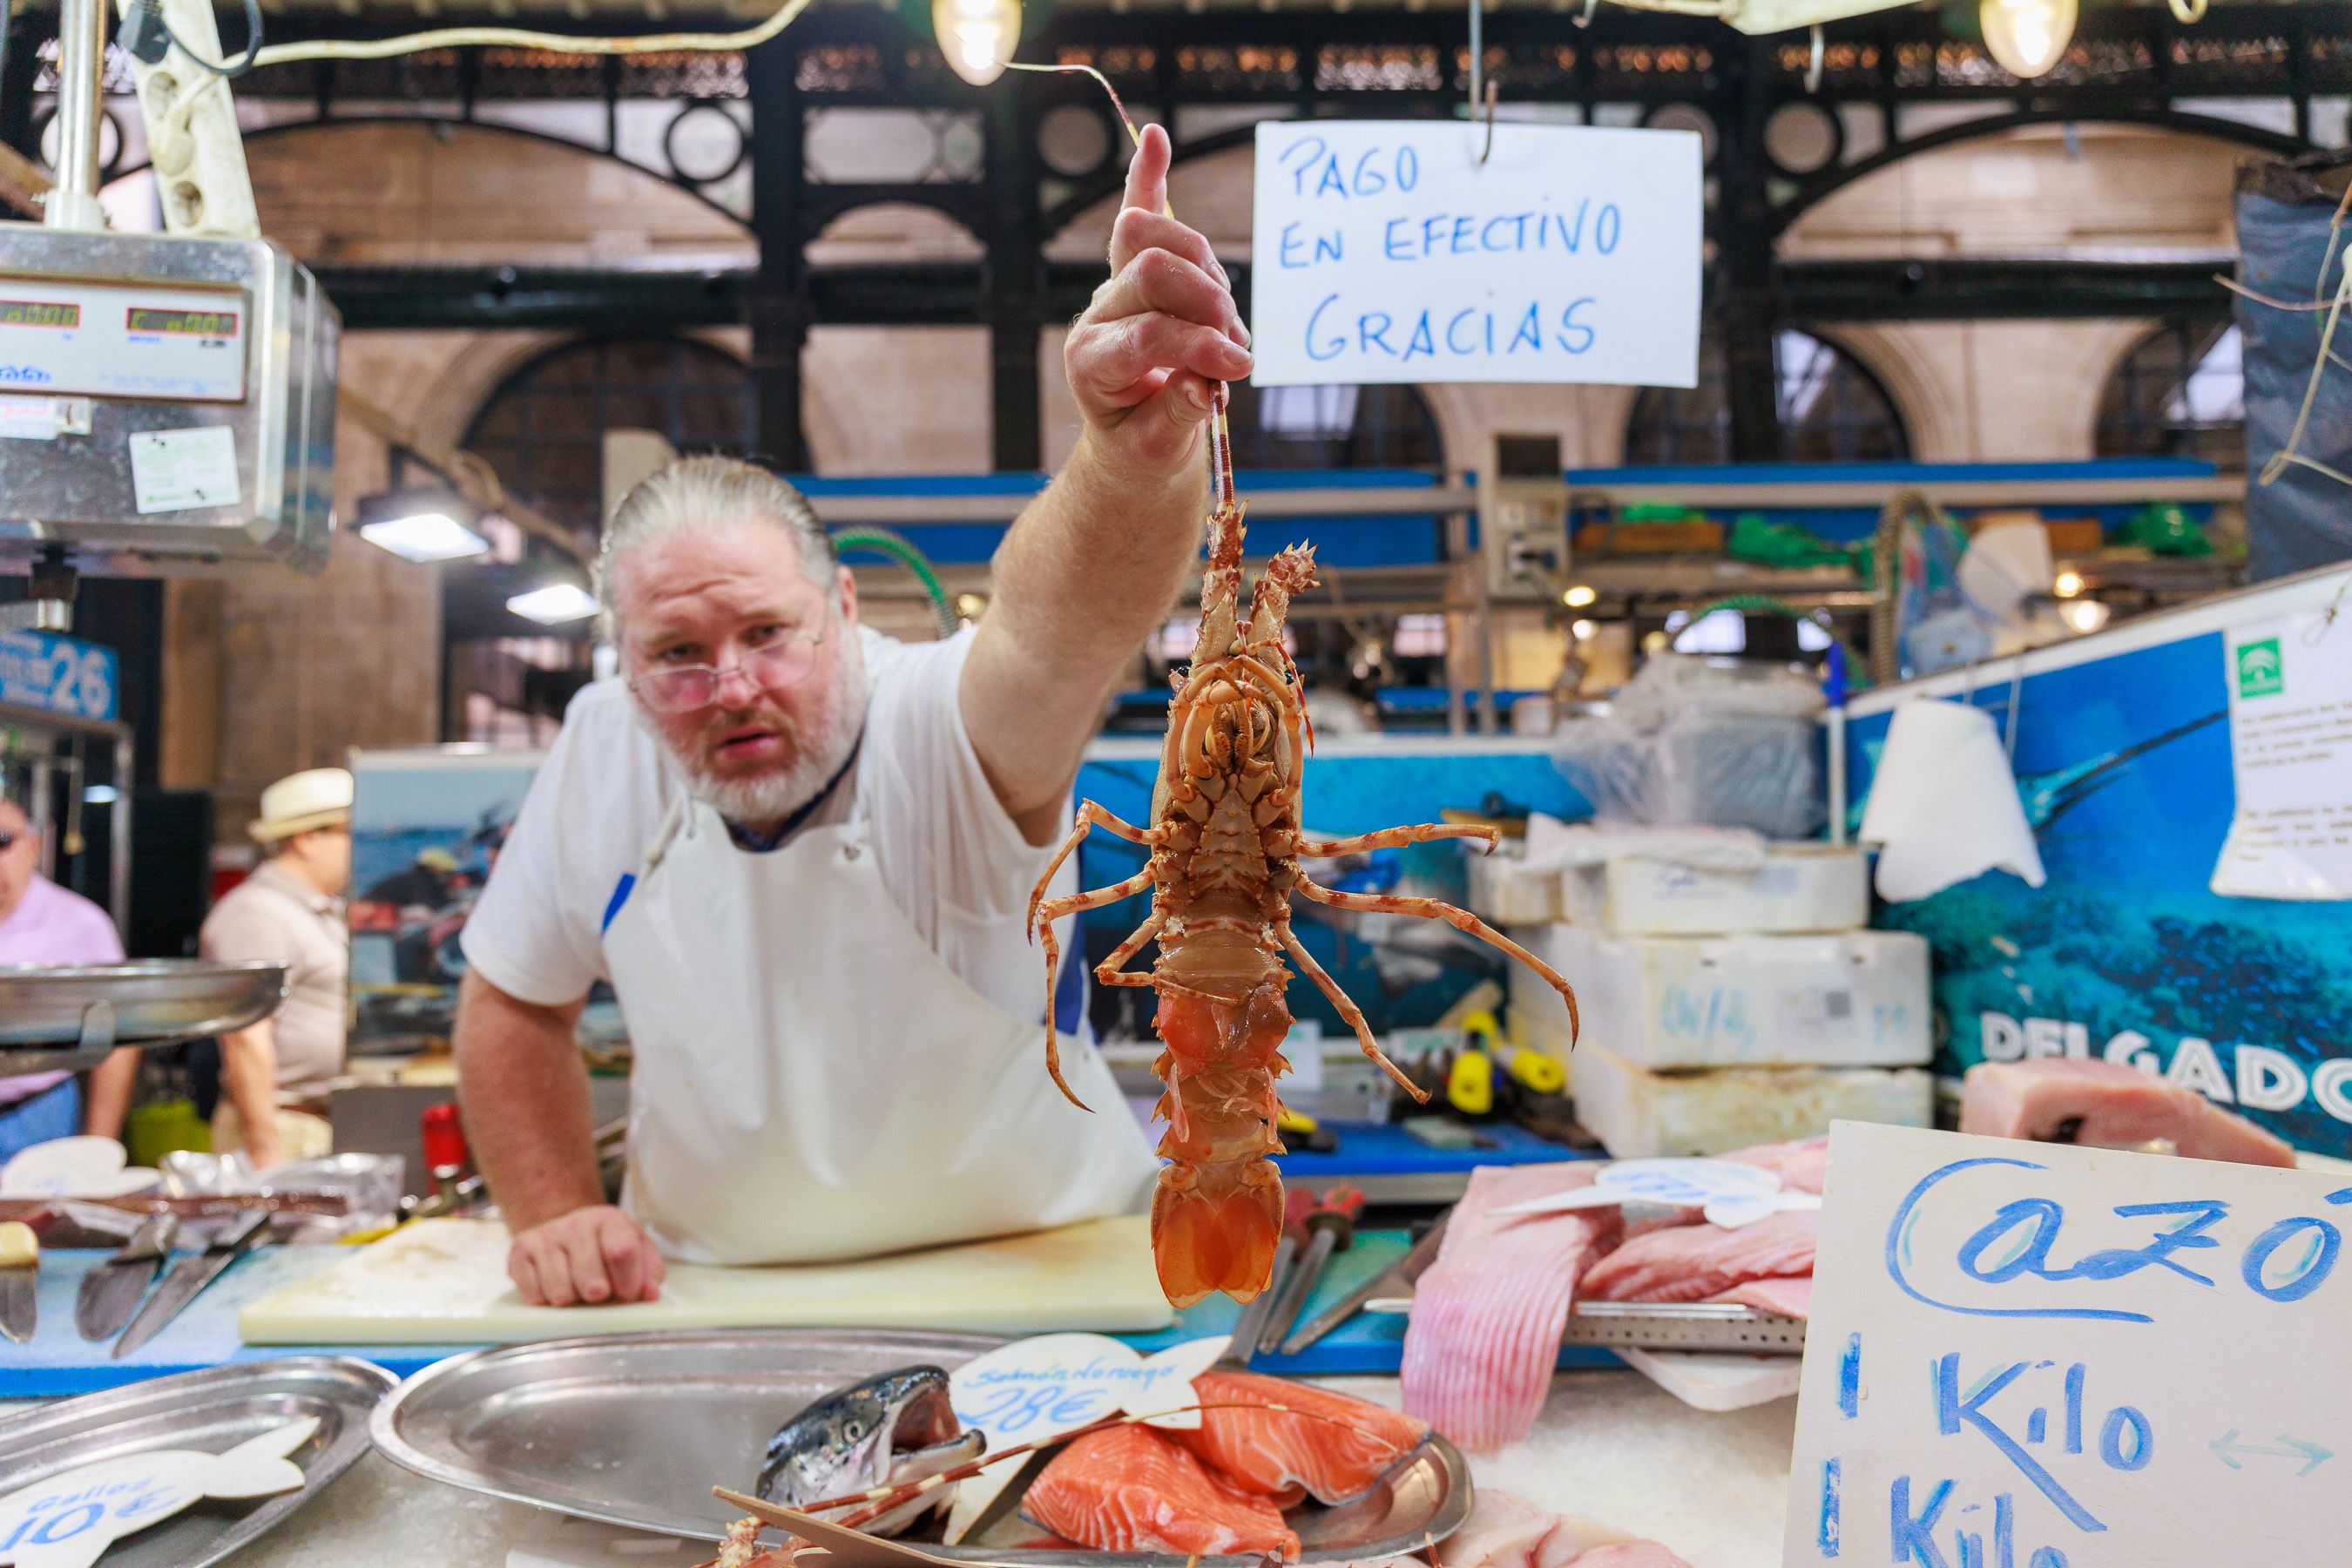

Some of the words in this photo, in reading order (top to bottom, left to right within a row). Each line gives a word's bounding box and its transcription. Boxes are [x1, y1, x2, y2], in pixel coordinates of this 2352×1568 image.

[1278, 136, 1418, 199] PAGO
[1279, 220, 1344, 269] EN
[1383, 195, 1622, 261] EFECTIVO
[1306, 289, 1597, 363] GRACIAS
[51, 642, 112, 716] 26
[1930, 1351, 2154, 1532] Kilo
